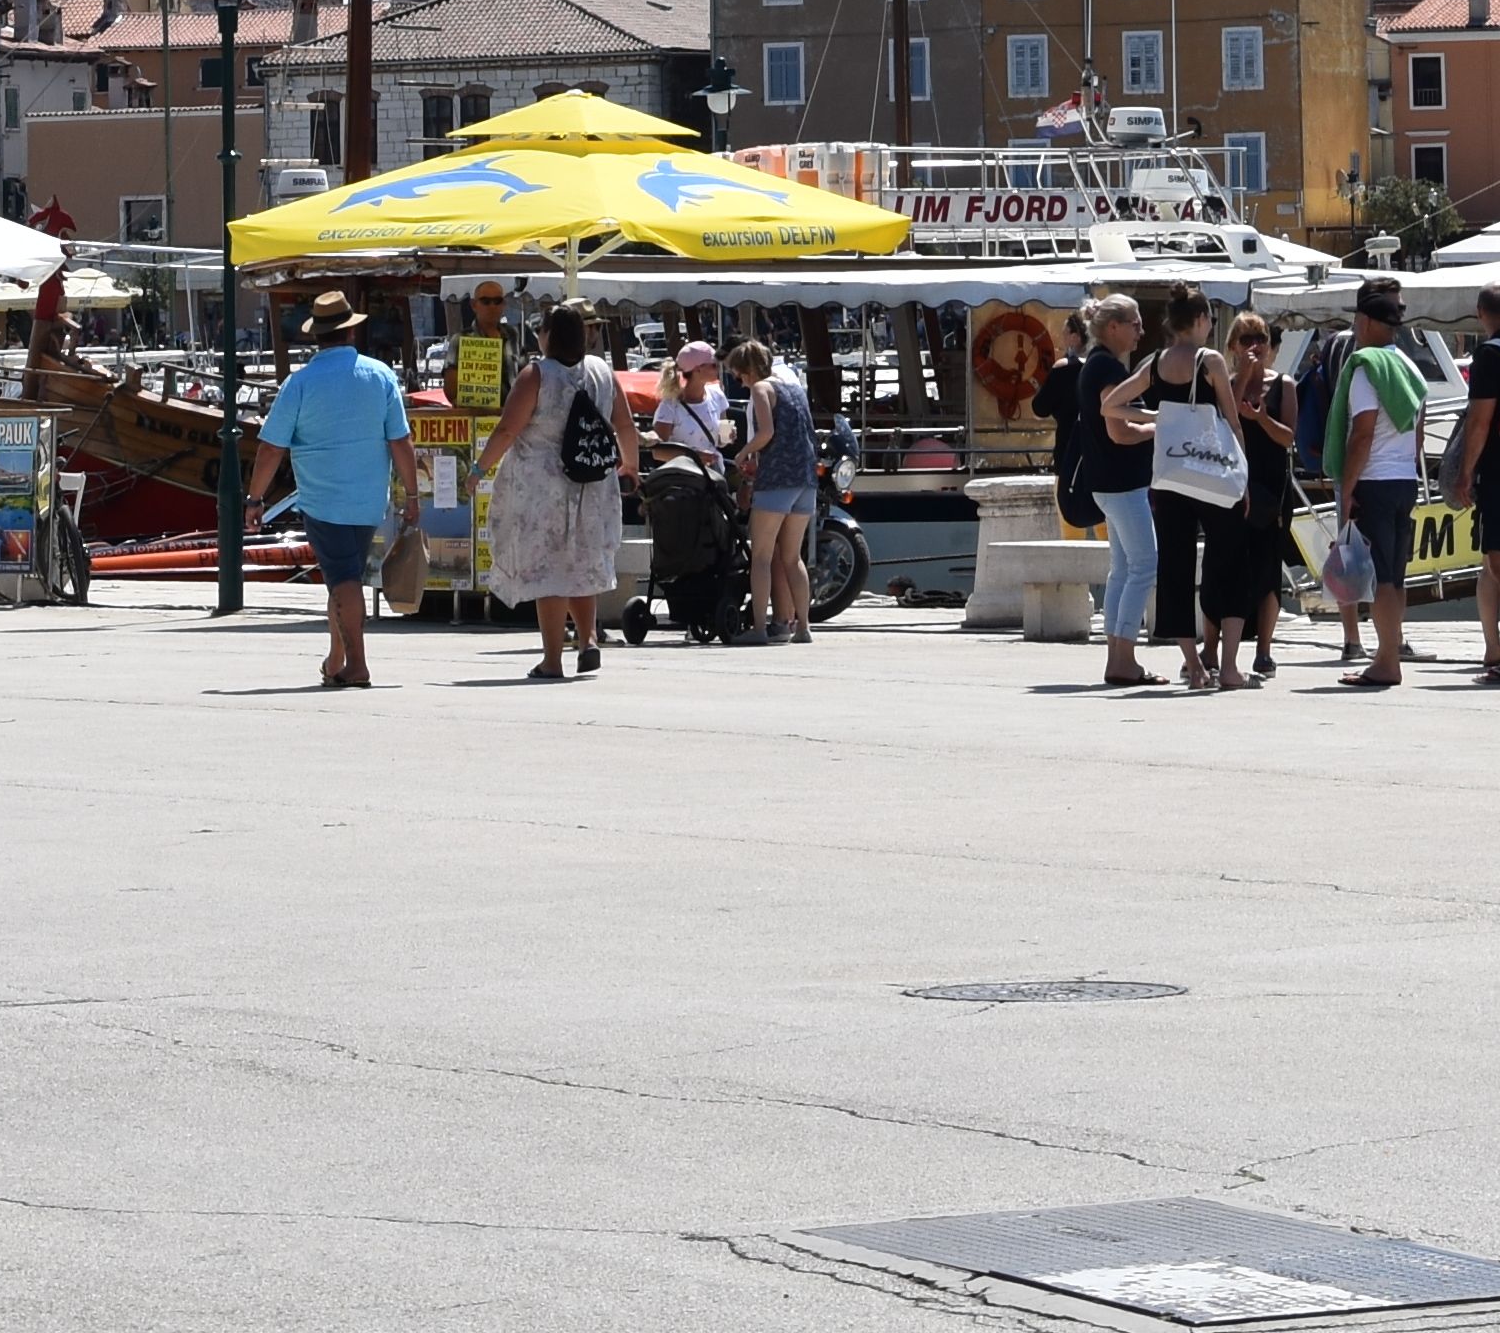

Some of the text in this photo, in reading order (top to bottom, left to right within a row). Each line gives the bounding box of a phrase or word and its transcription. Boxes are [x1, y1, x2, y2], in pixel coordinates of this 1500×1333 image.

[894, 194, 949, 223] LIM
[965, 194, 1069, 223] FJORD
[317, 223, 494, 241] excursion DELFIN
[702, 225, 836, 247] excursion DELFIN
[420, 418, 469, 443] DELFIN
